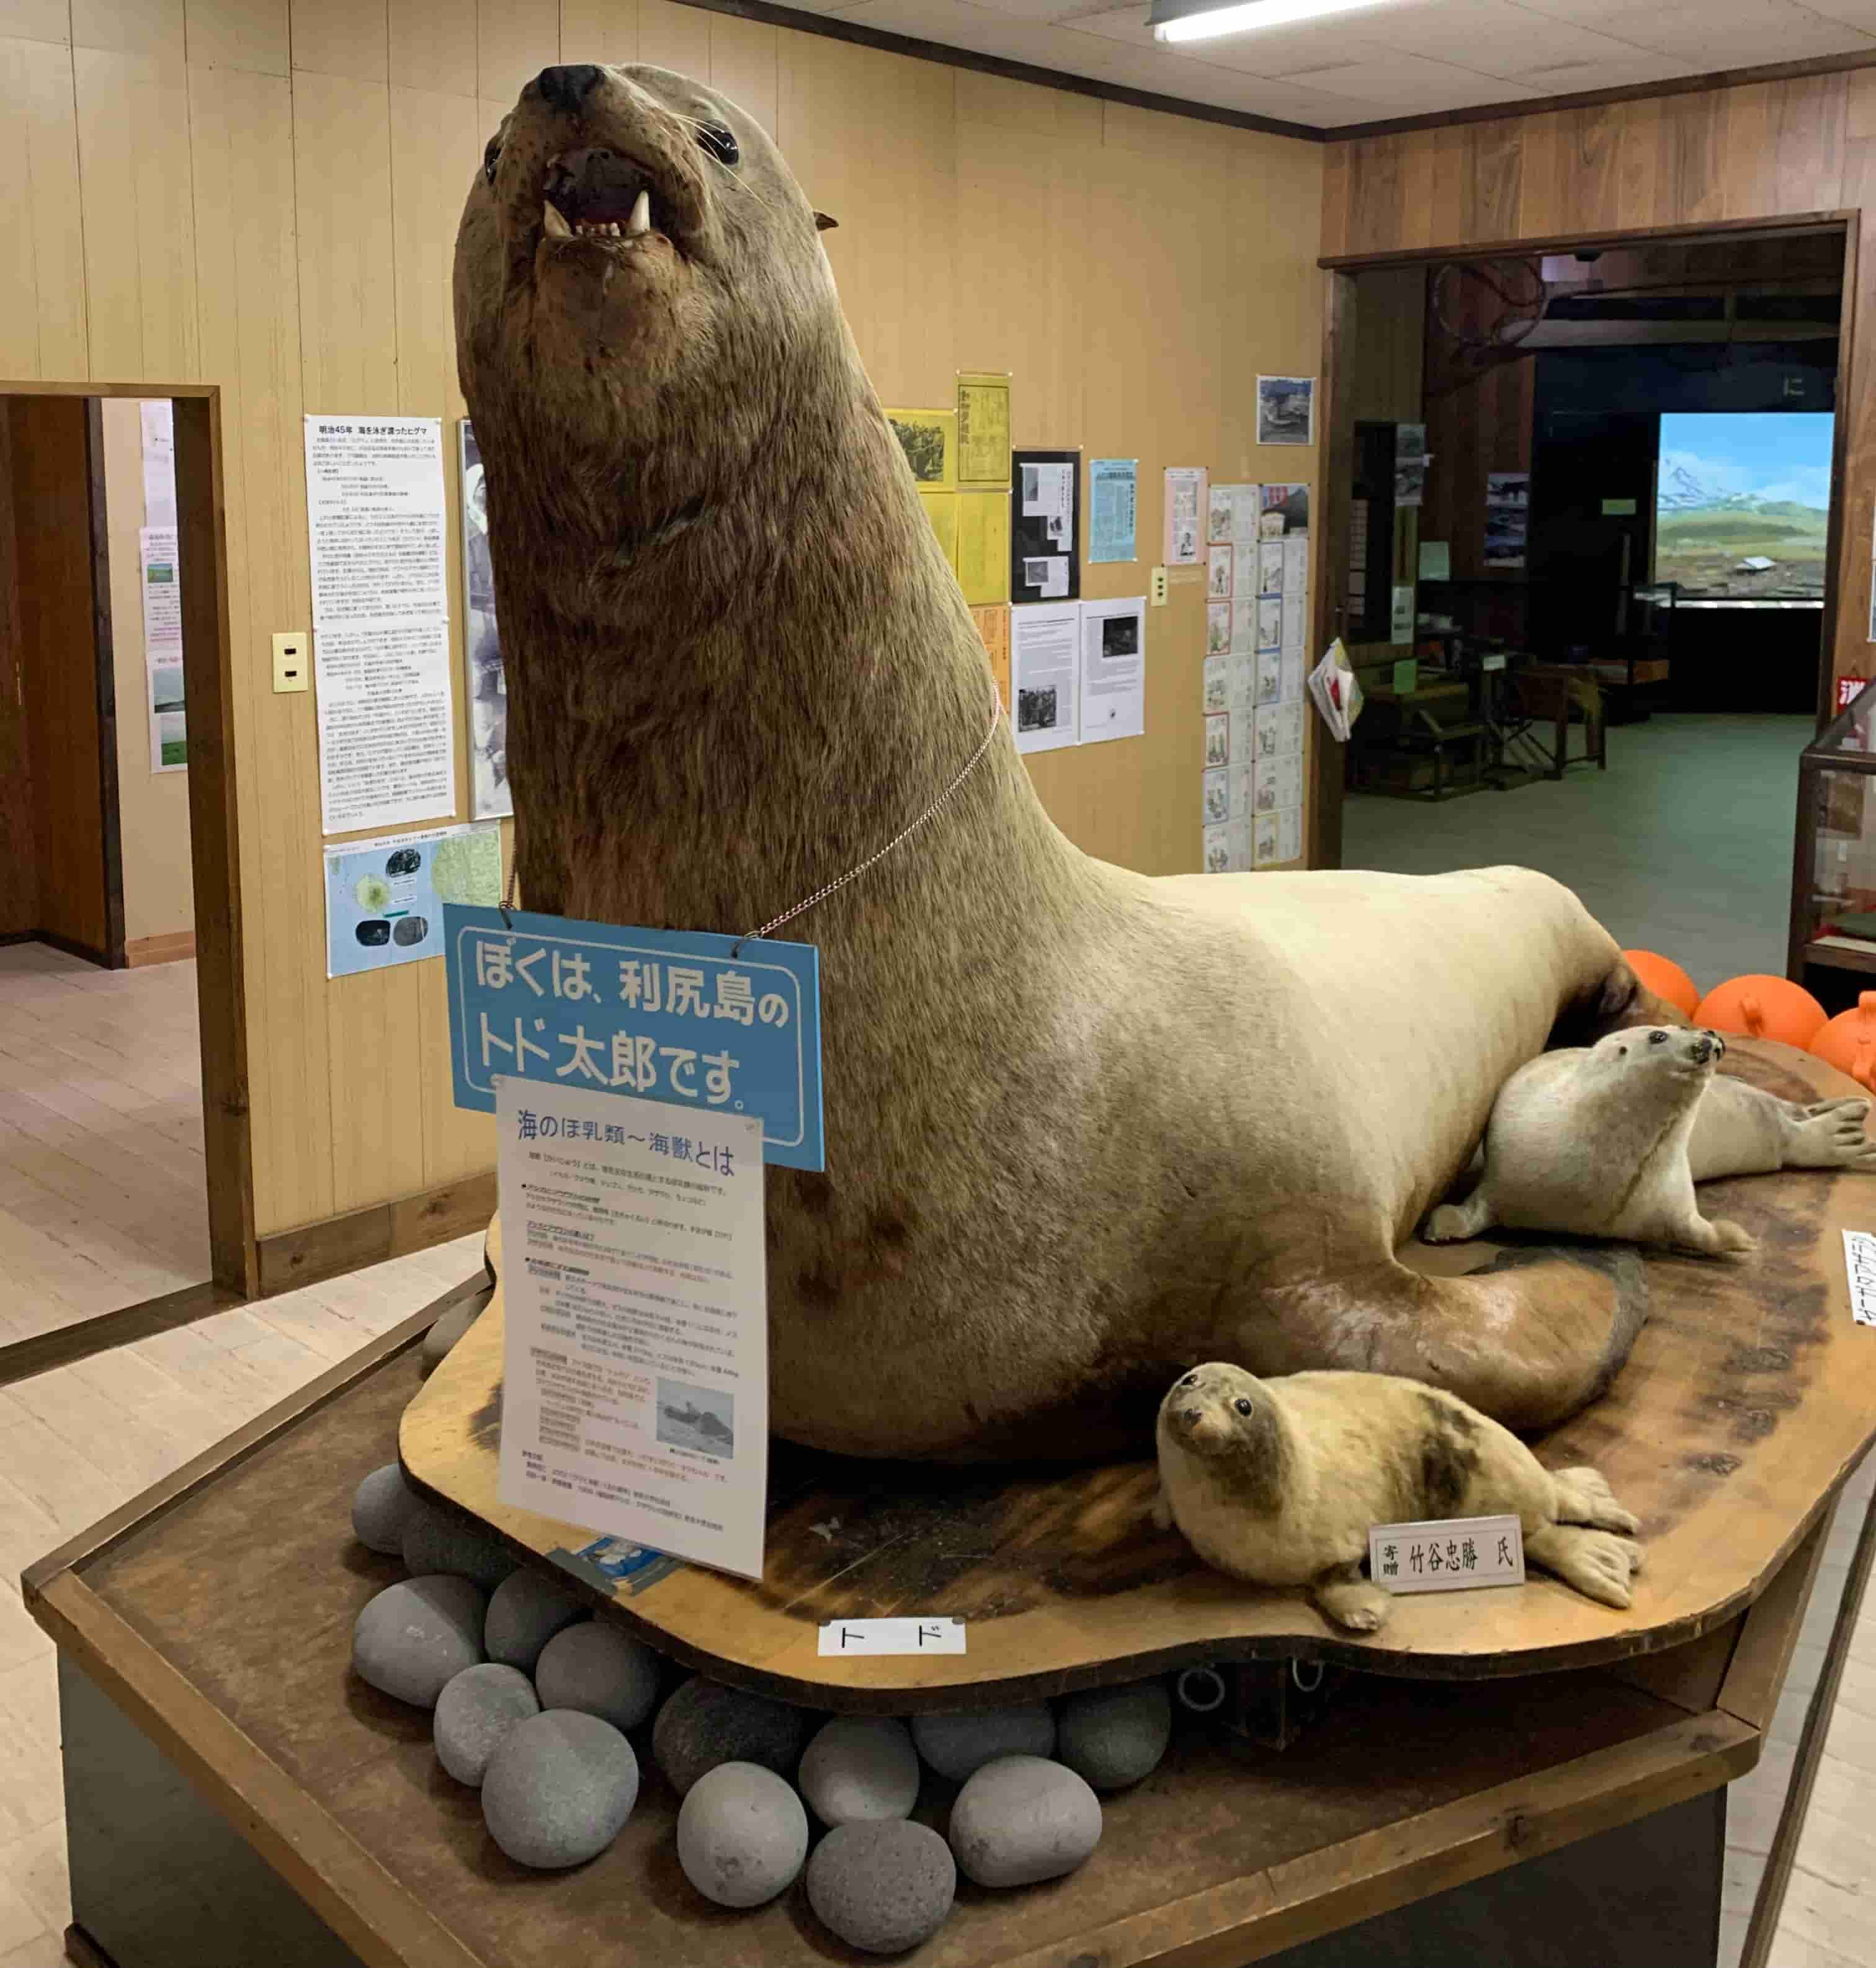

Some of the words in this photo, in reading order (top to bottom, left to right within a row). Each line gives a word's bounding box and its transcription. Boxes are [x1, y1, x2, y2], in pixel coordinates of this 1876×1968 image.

[476, 937, 789, 1028] ぼくは、利尻島の
[480, 1011, 744, 1110] トド太郎です。
[1409, 1537, 1478, 1574] 竹谷忠勝
[1497, 1536, 1513, 1567] 氏
